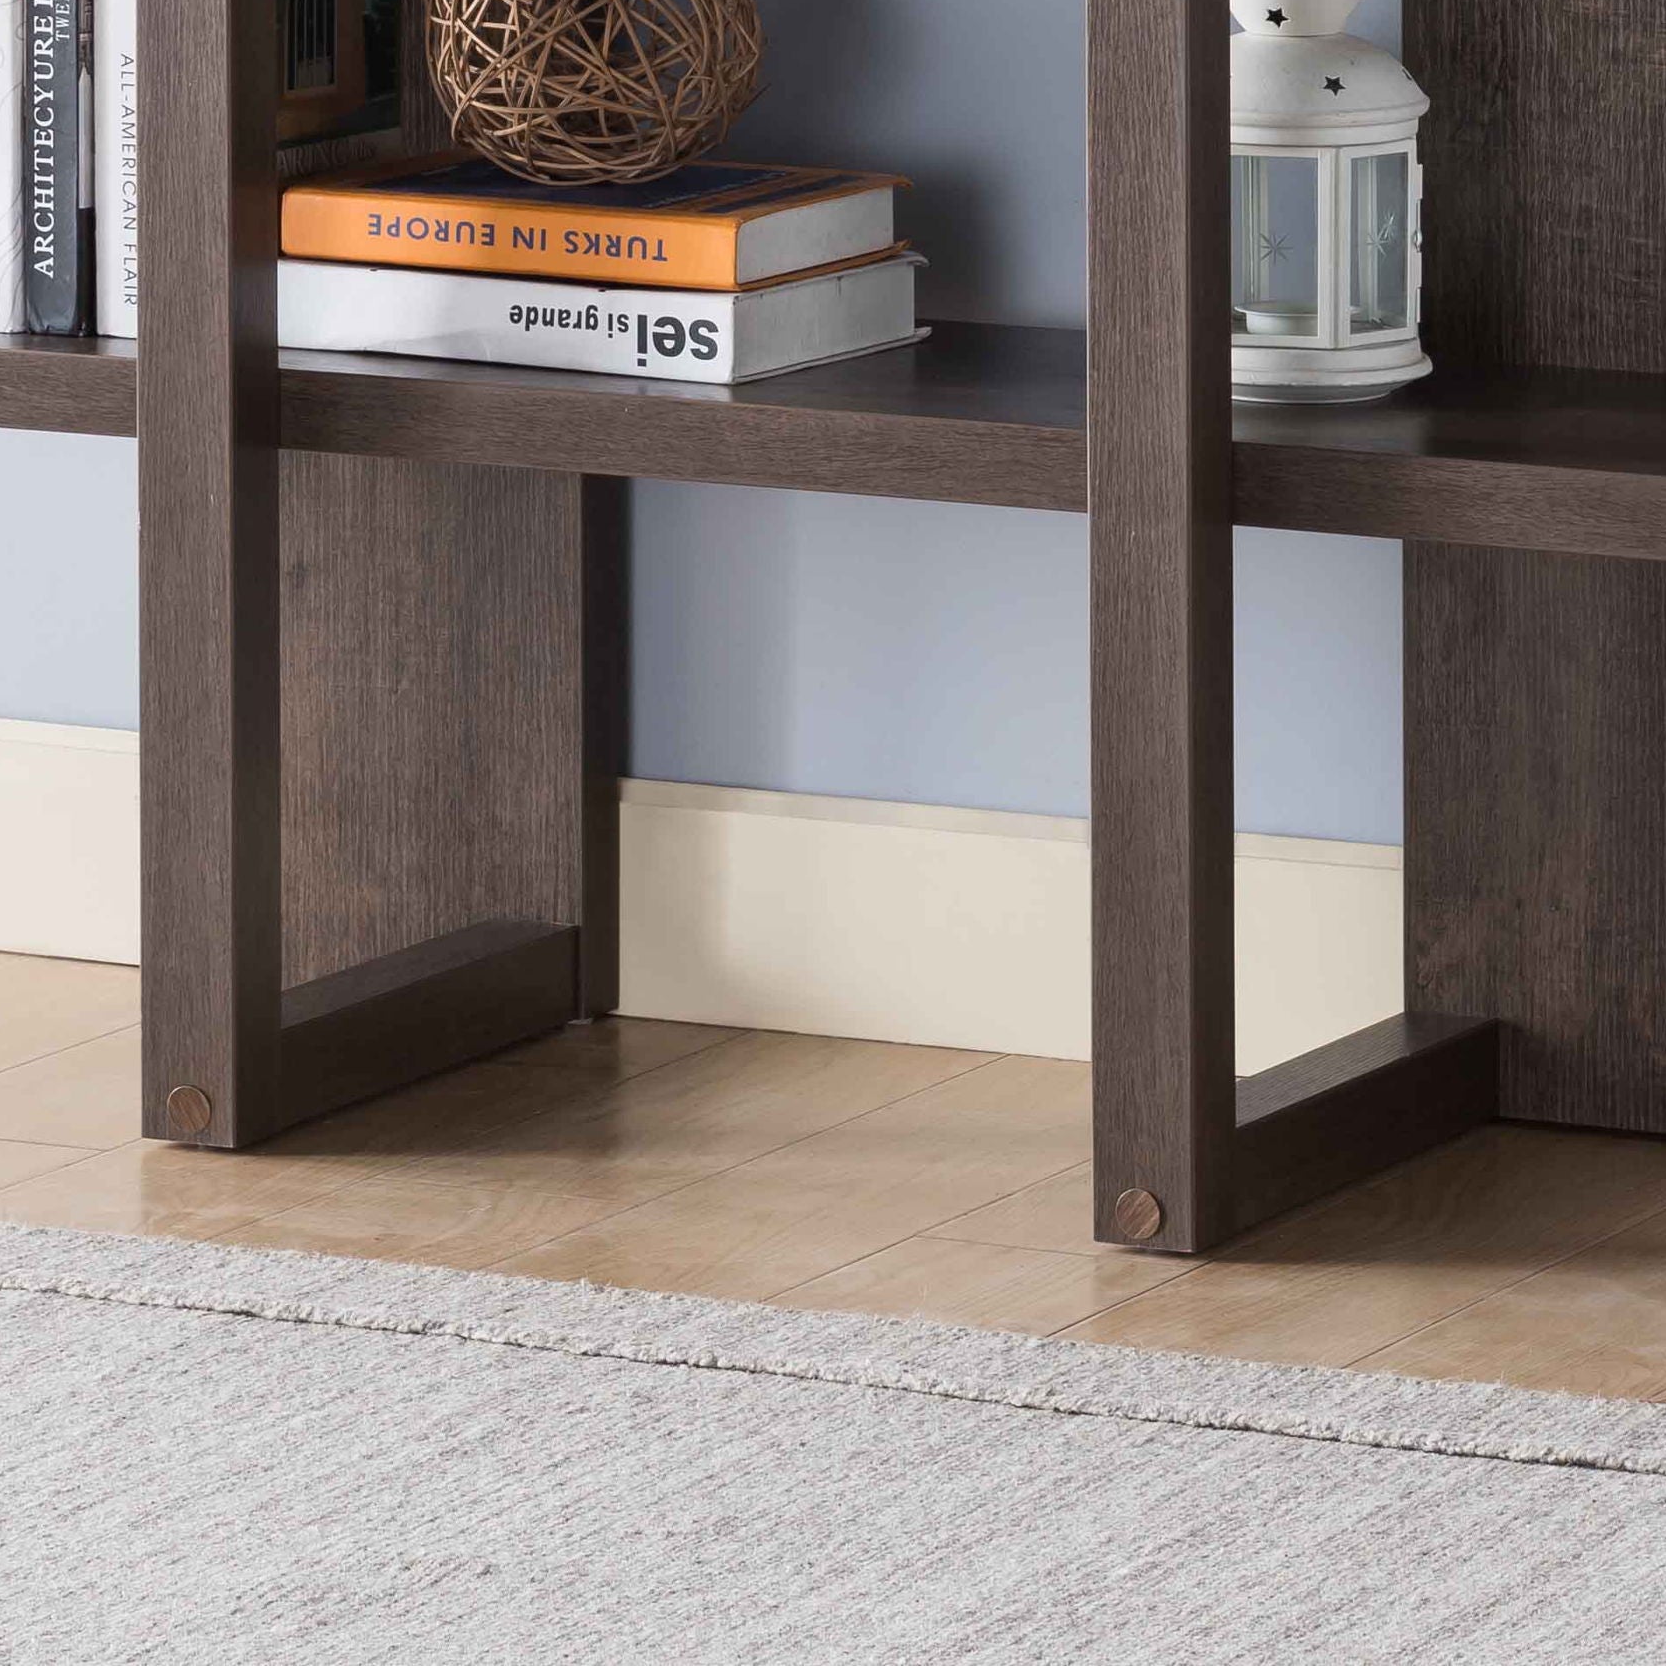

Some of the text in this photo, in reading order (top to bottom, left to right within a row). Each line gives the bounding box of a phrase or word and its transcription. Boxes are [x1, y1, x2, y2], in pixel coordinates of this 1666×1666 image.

[32, 16, 54, 279] ARCHITECYURE
[119, 52, 138, 306] ALL-AMERICAN FLAIR
[367, 214, 669, 263] TURKS IN EUROPE
[509, 305, 720, 368] sei si grande
